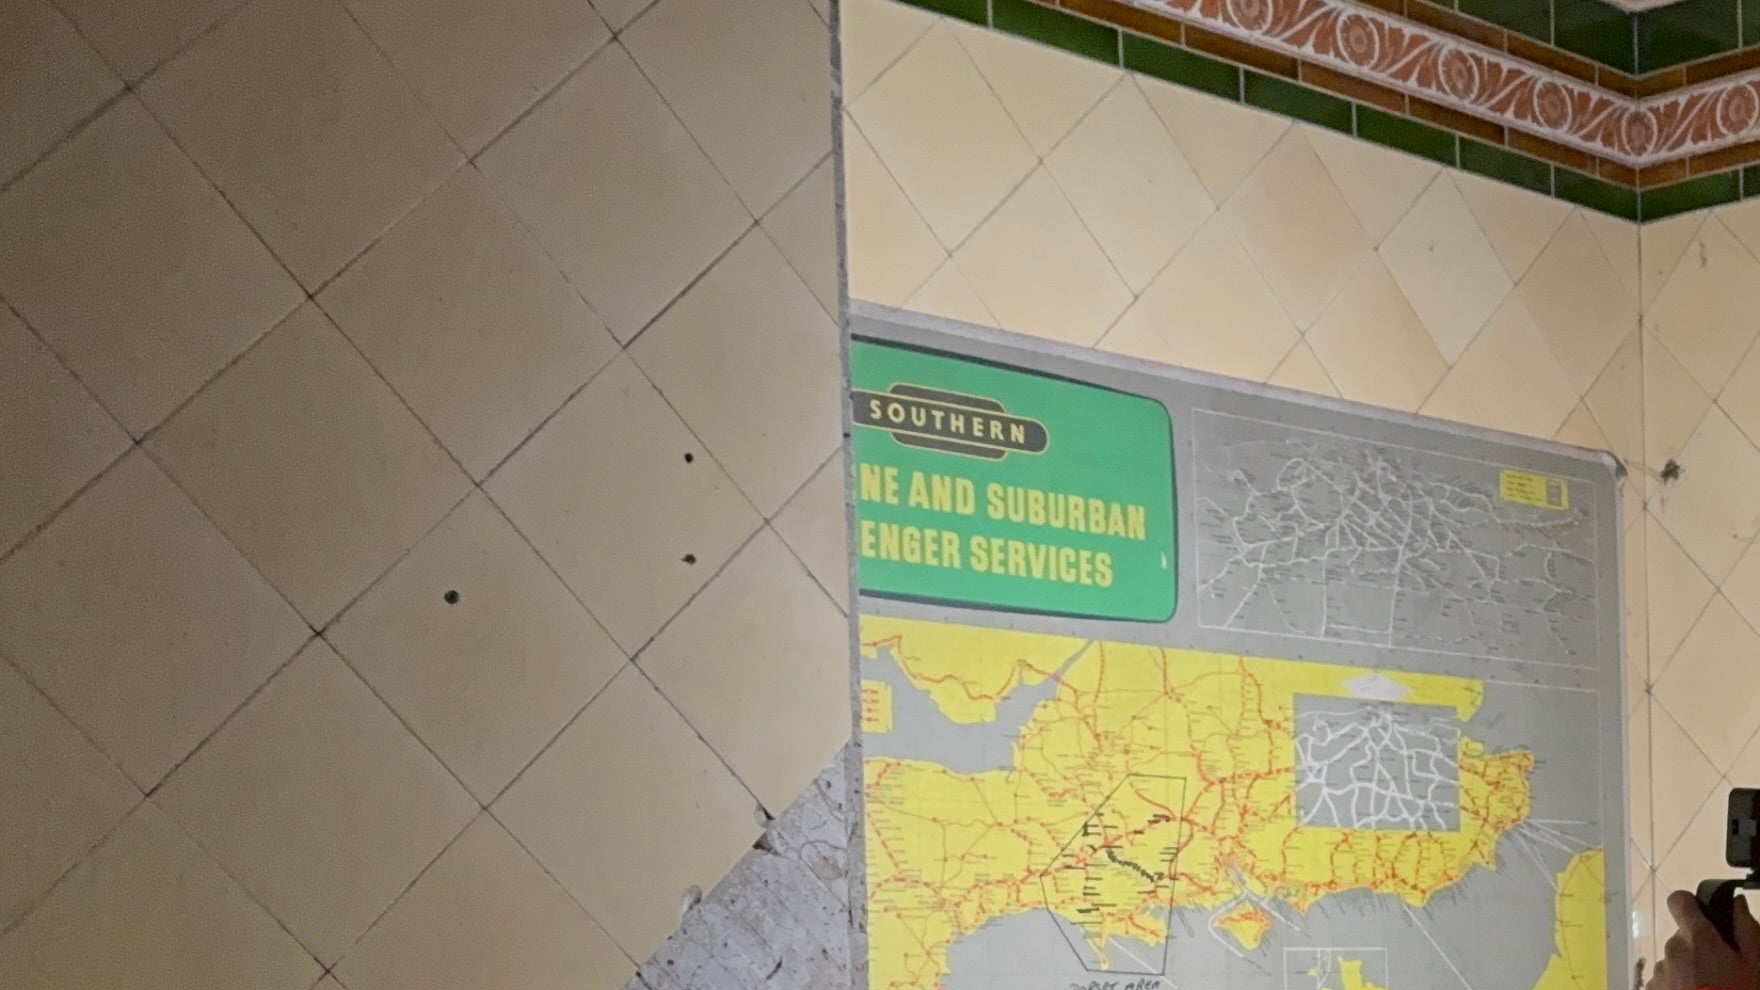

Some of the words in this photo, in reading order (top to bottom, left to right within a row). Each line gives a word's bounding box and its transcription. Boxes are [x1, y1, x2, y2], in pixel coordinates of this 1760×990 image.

[869, 398, 1026, 445] SOUTHERN
[908, 471, 976, 517] AND
[986, 482, 1146, 540] SUBURBAN
[860, 519, 962, 570] ENGER
[969, 535, 1114, 588] SERVICES
